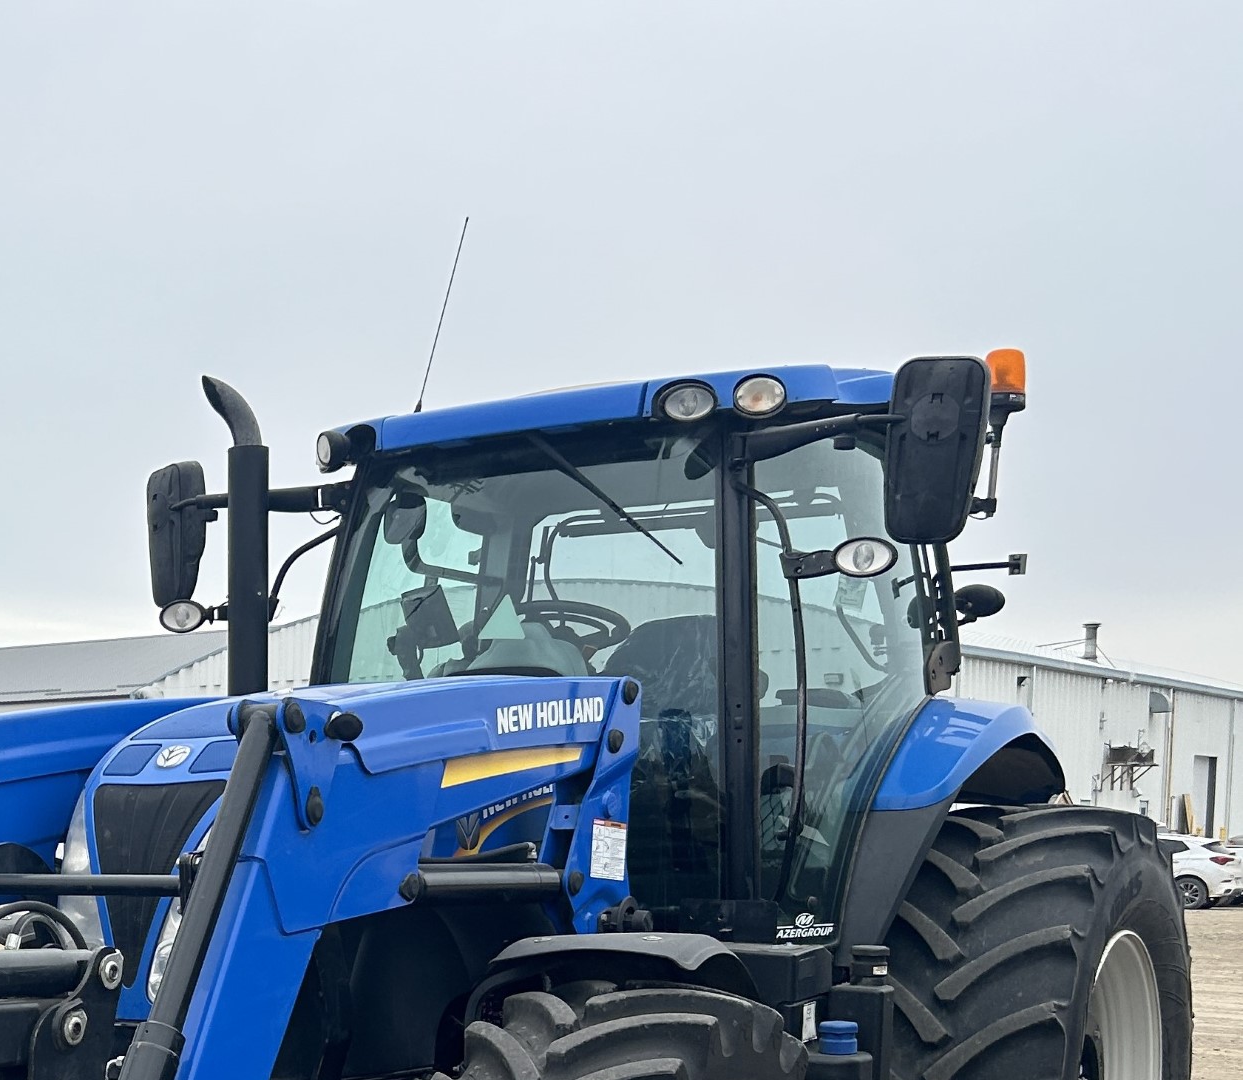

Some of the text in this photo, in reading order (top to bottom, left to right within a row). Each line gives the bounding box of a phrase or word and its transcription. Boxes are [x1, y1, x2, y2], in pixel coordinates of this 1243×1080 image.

[496, 696, 604, 735] NEW HOLLAND
[776, 926, 834, 939] AZERGROUP
